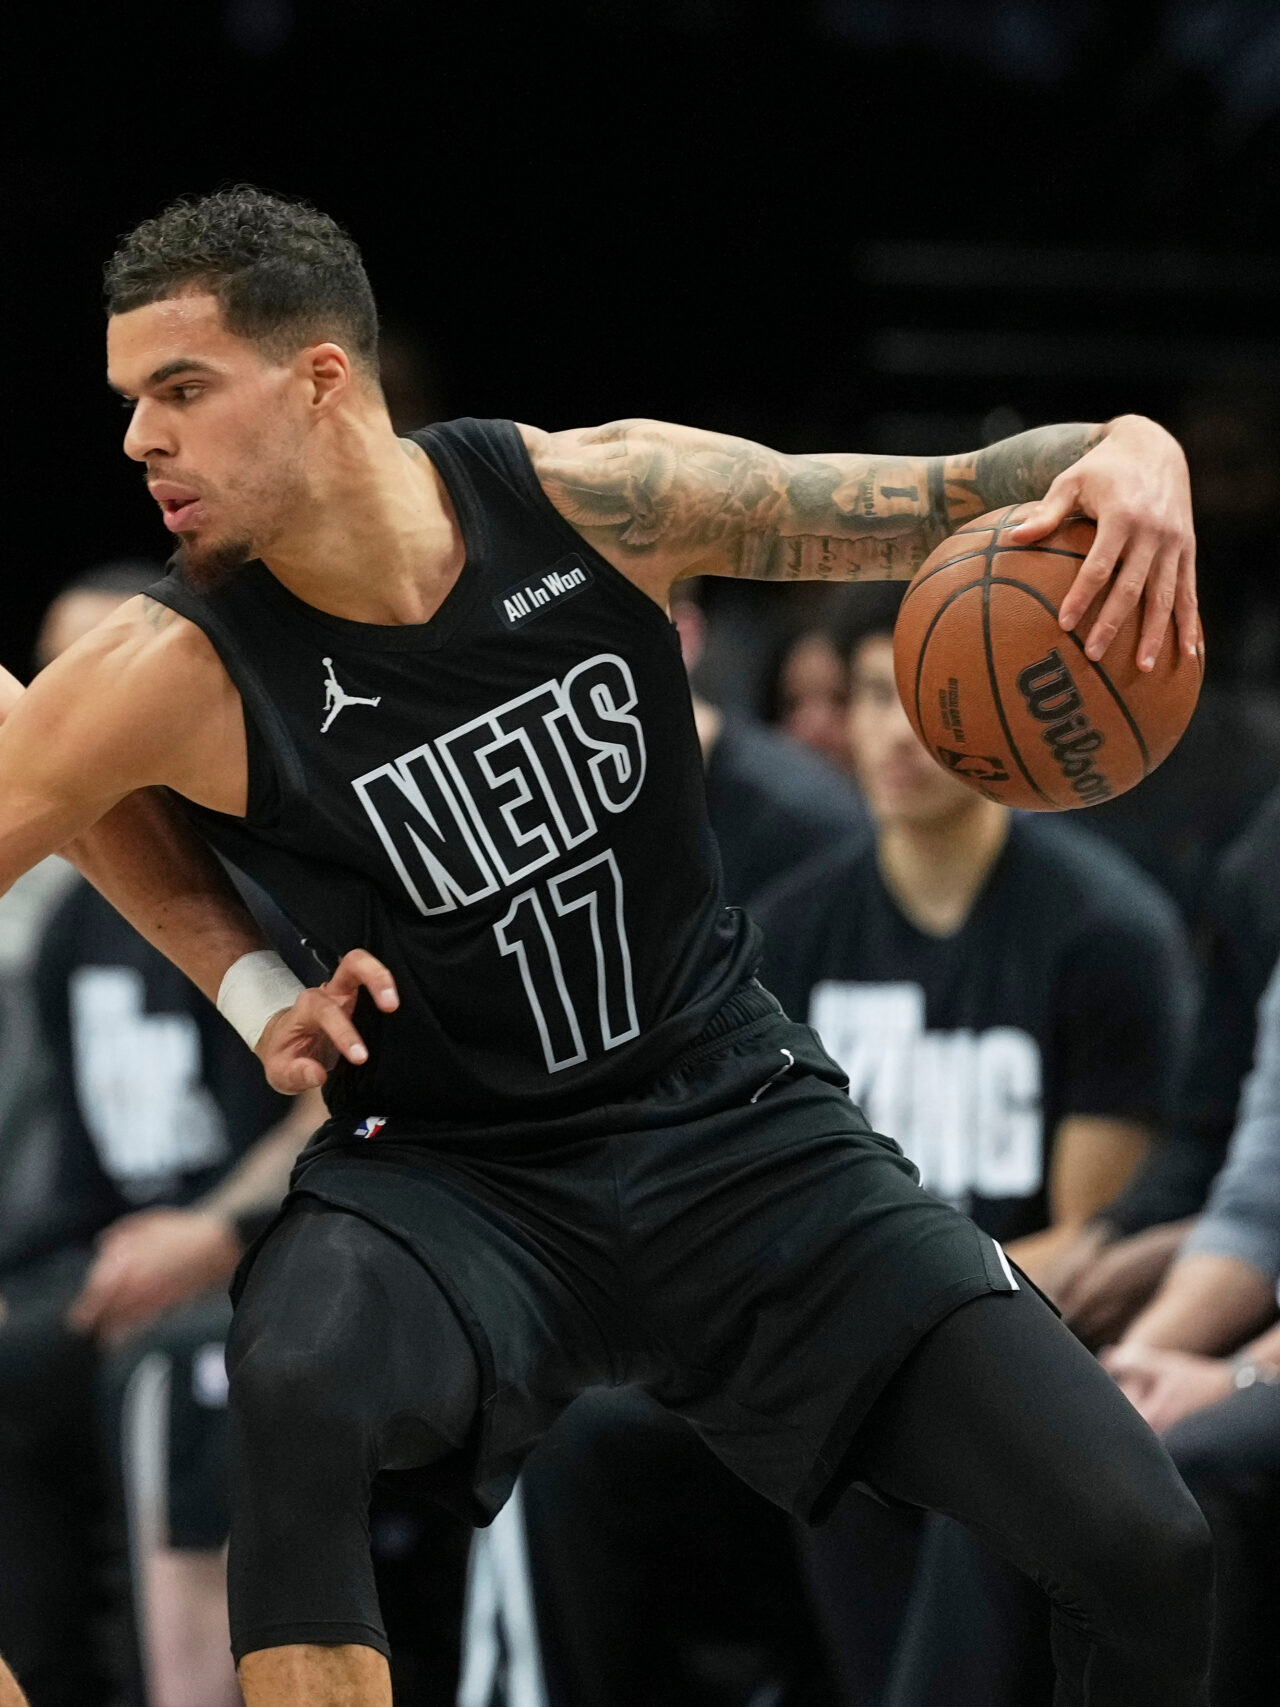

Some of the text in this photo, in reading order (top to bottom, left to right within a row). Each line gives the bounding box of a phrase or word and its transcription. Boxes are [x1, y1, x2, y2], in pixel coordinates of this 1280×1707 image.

[881, 485, 918, 501] 1
[503, 567, 587, 623] All In Won
[351, 653, 647, 917] NETS
[1017, 647, 1112, 804] Wilson
[493, 848, 640, 1074] 17
